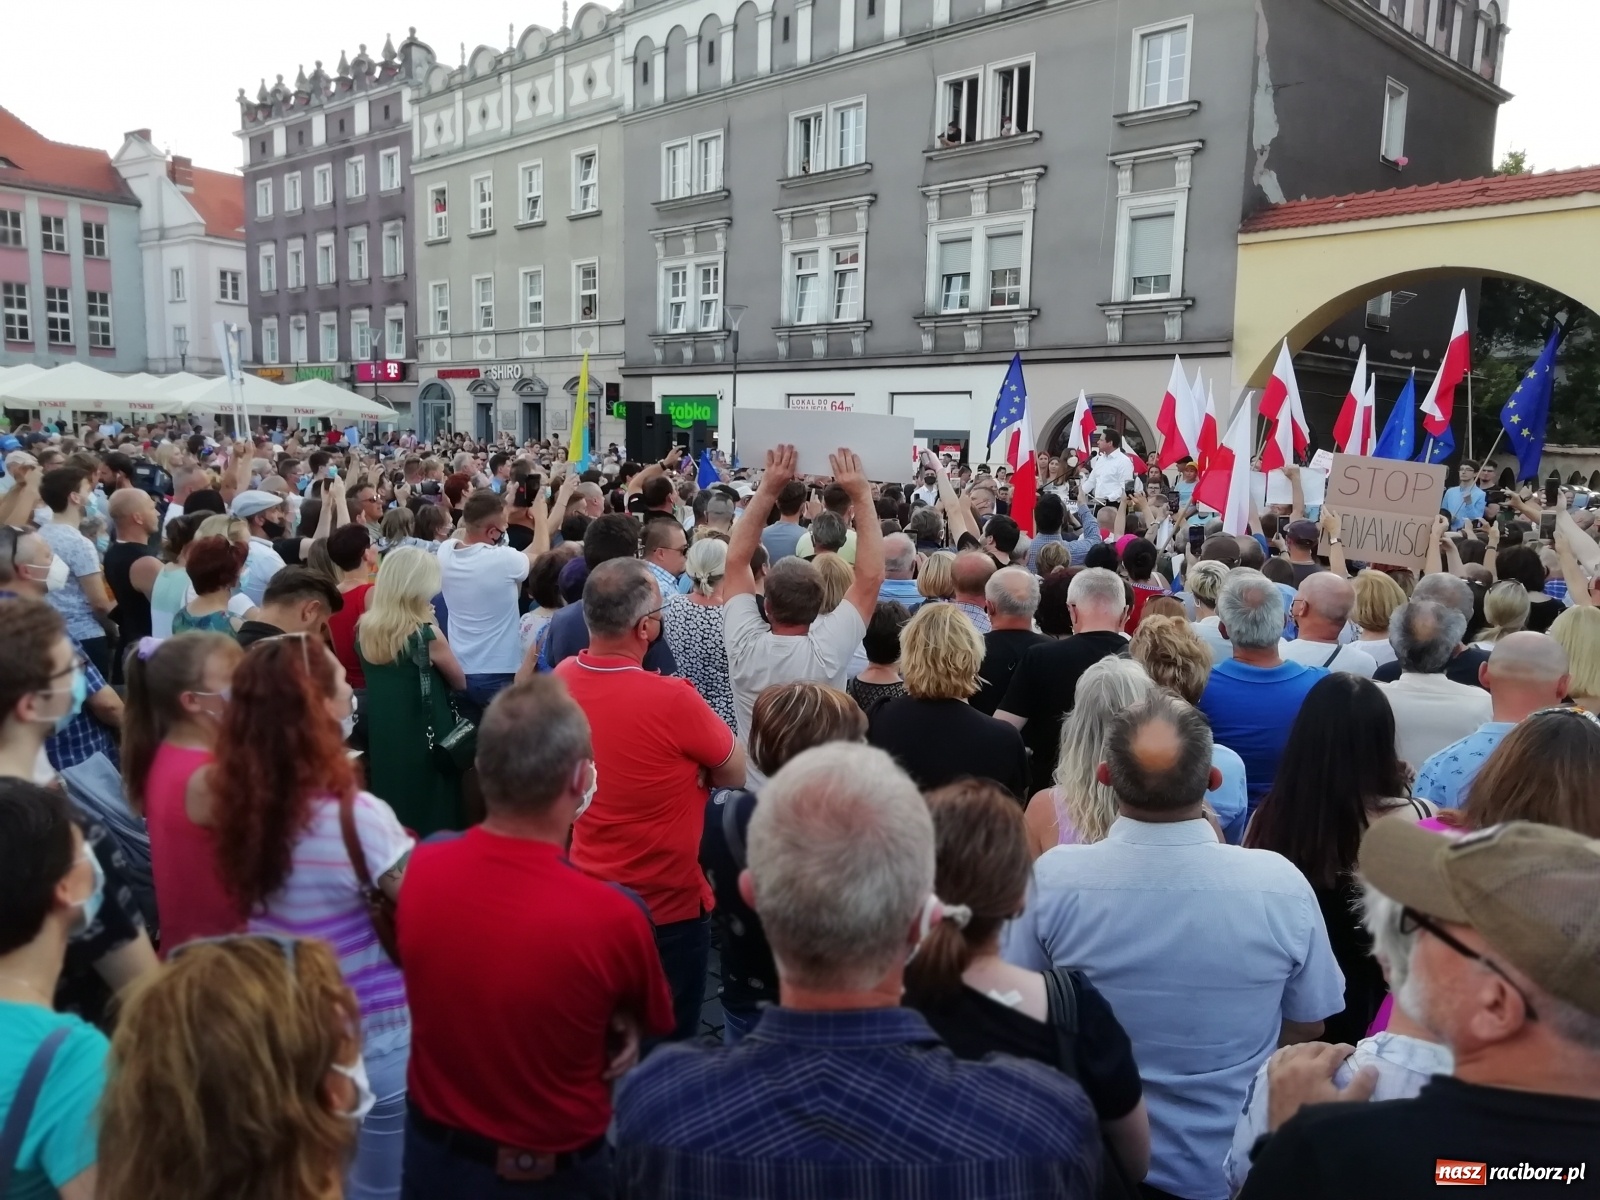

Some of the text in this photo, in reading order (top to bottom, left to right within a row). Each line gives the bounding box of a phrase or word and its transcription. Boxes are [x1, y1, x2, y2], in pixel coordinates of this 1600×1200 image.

[387, 362, 398, 378] T
[491, 364, 522, 380] SHIRO
[38, 400, 67, 408] TYSKIE
[128, 402, 155, 410] TYSKIE
[293, 407, 316, 415] TYSKIE
[360, 412, 379, 420] TYSKIE
[668, 402, 711, 420] żabka
[1338, 465, 1434, 503] STOP
